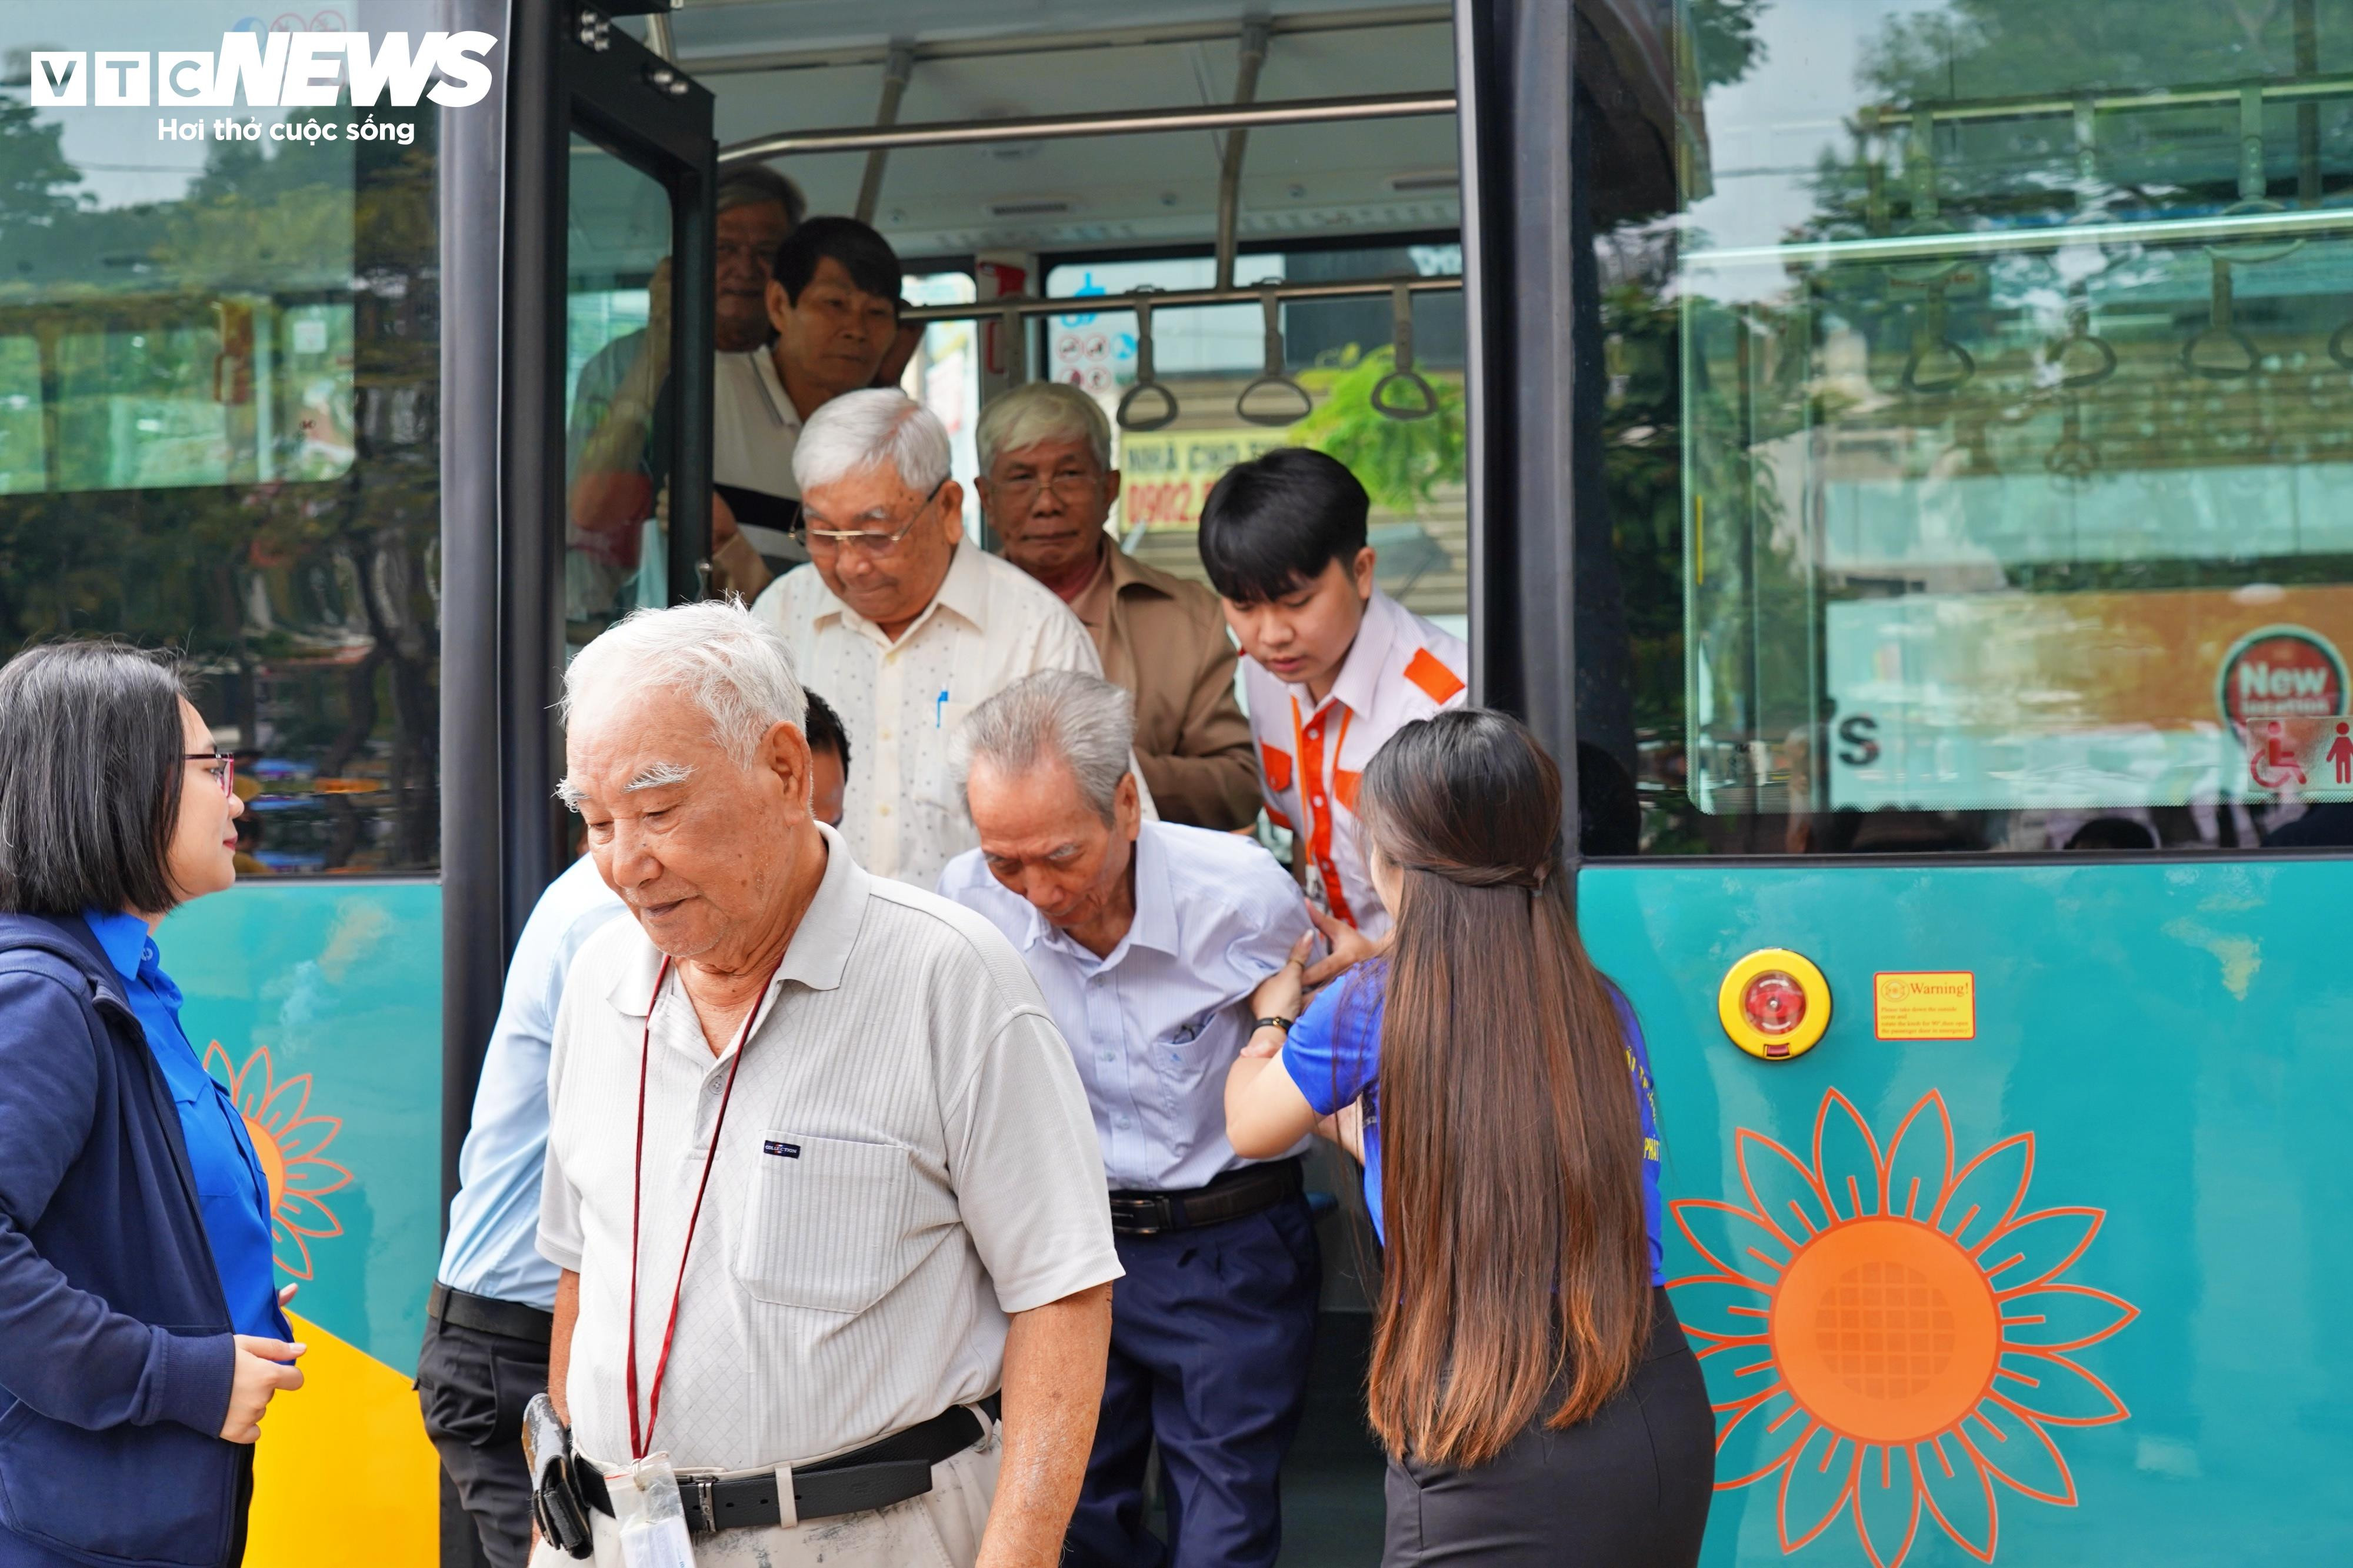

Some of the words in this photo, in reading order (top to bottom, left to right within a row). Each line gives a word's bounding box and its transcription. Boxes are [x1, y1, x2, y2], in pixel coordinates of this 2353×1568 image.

[2238, 660, 2328, 697] New
[1910, 982, 1969, 998] Warning!
[765, 1145, 797, 1153] COLLECTION
